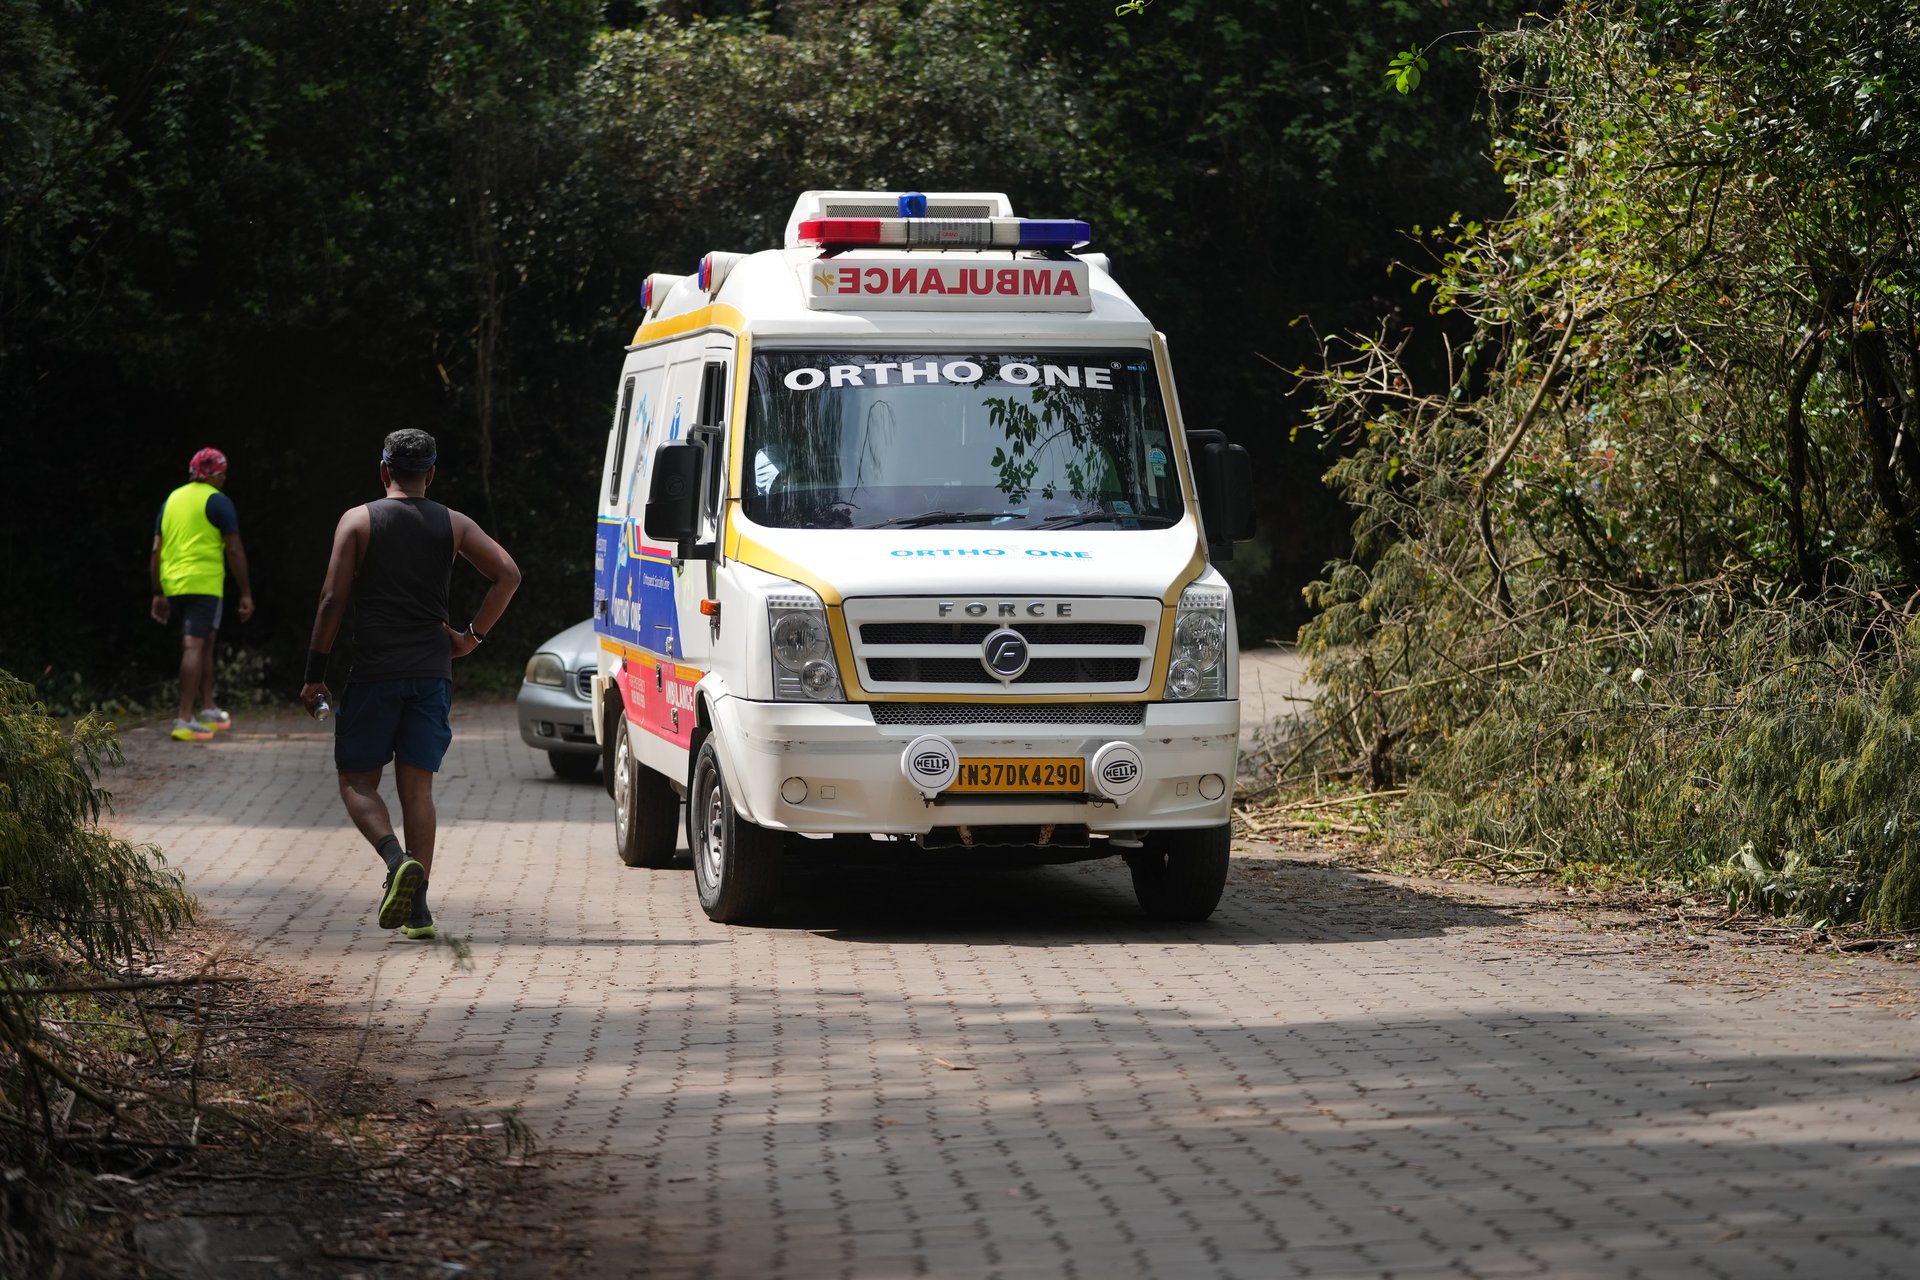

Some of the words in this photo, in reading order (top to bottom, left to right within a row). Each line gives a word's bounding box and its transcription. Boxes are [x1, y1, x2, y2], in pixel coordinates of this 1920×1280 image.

[784, 361, 984, 391] ORTHO
[890, 548, 1006, 557] ORTHO
[1024, 549, 1093, 559] ONE
[938, 602, 1073, 617] FORCE
[915, 758, 950, 770] HELLA
[957, 764, 1081, 786] TN37DK4290
[1105, 765, 1137, 777] HELLA
